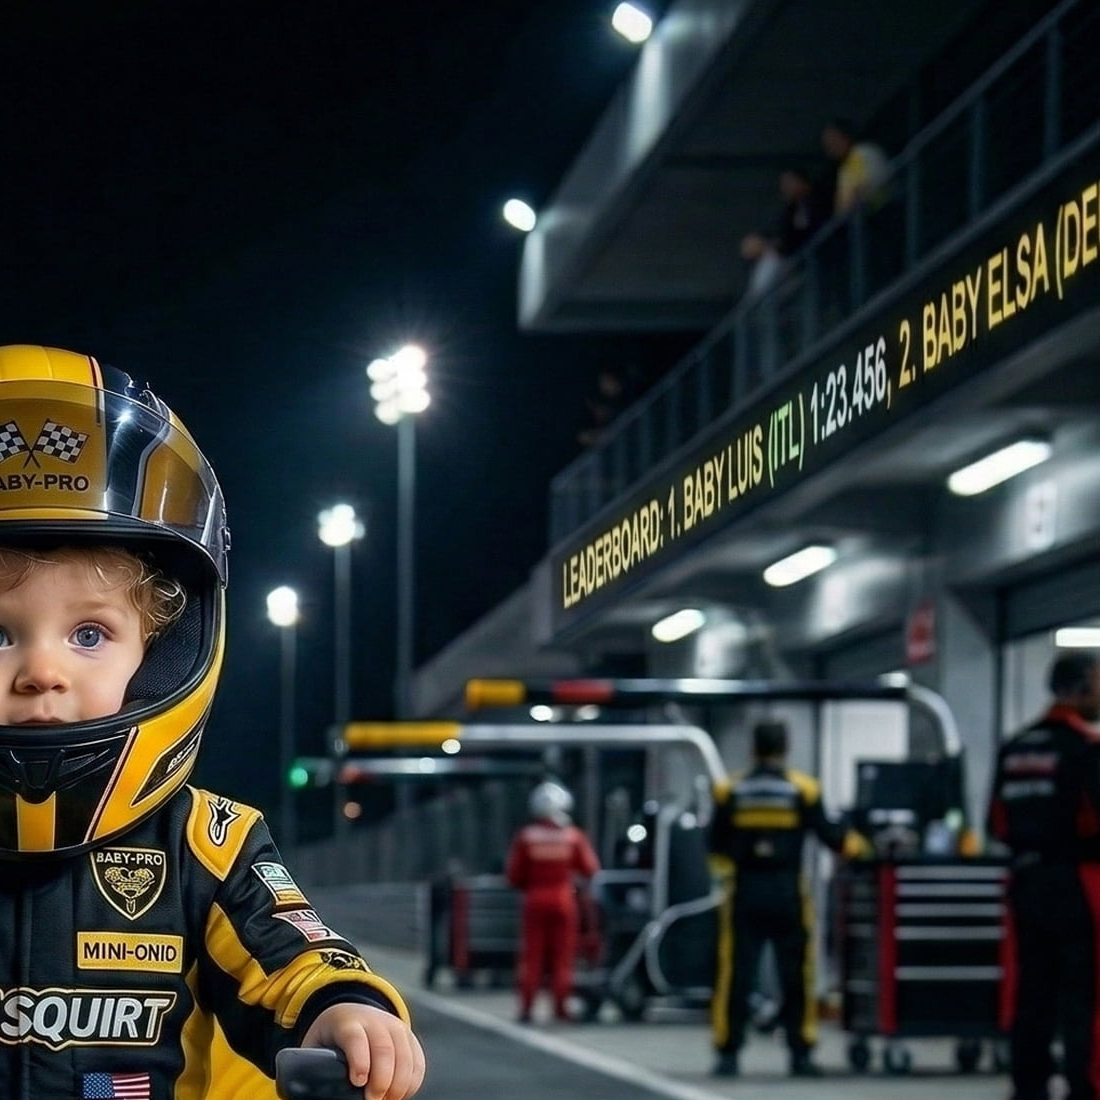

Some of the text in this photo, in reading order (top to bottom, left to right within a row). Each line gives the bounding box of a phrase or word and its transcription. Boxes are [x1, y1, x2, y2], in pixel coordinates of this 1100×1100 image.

[563, 500, 665, 609] LEADERBOARD:
[668, 485, 682, 540] 1.
[684, 450, 725, 532] BABY
[728, 424, 763, 503] LUIS
[768, 392, 805, 488] (ITL)
[899, 319, 916, 389] 2.
[923, 265, 982, 373] BABY
[988, 222, 1050, 331] ELSA
[1055, 180, 1100, 300] (DE
[0, 995, 171, 1042] SQUIRT
